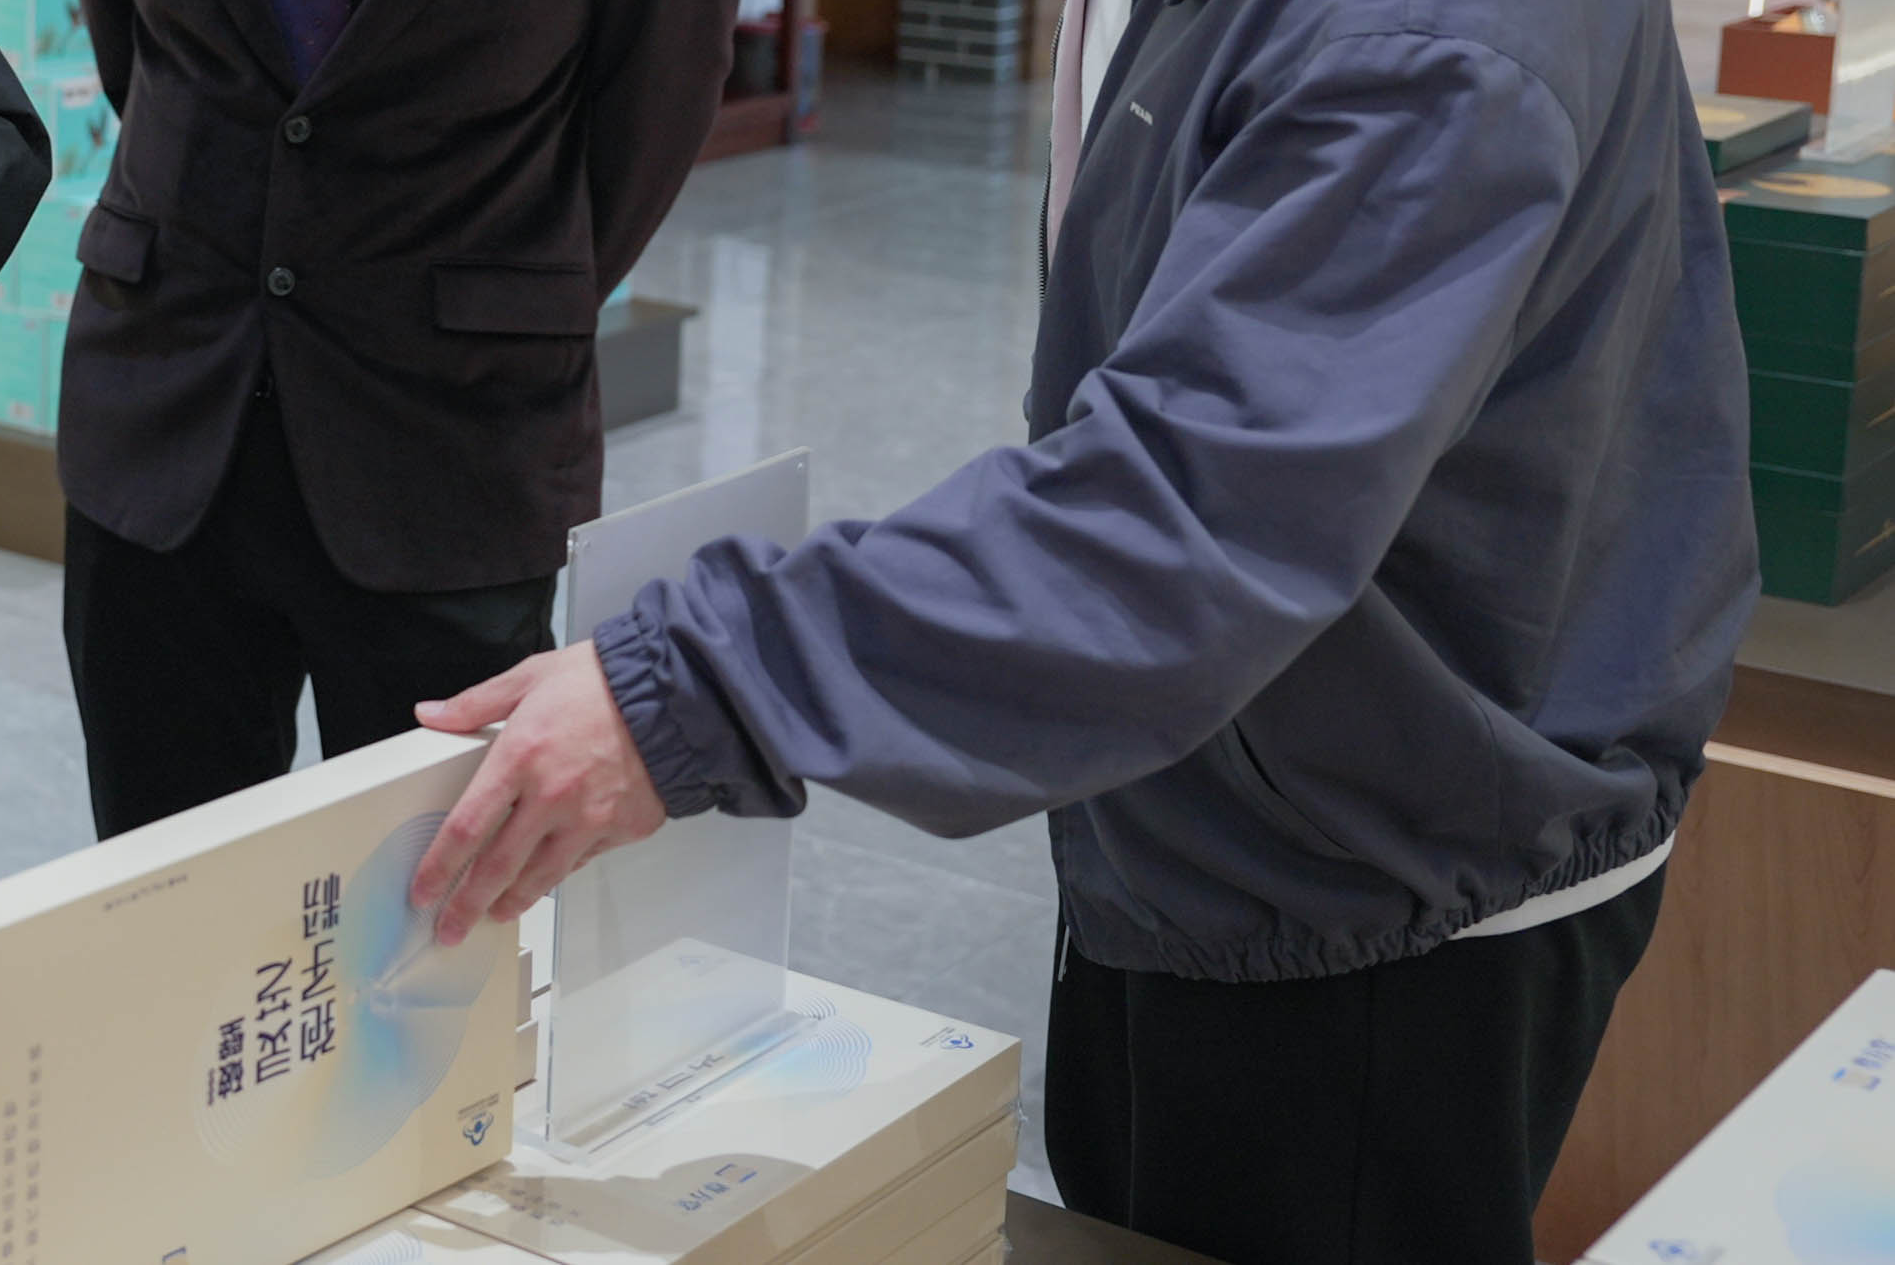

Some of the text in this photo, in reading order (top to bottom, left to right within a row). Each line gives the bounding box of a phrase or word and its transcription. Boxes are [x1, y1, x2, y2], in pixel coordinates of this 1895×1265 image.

[255, 957, 293, 1085] 灵芝
[300, 872, 341, 1062] 孢子粉
[217, 1015, 246, 1100] 破壁
